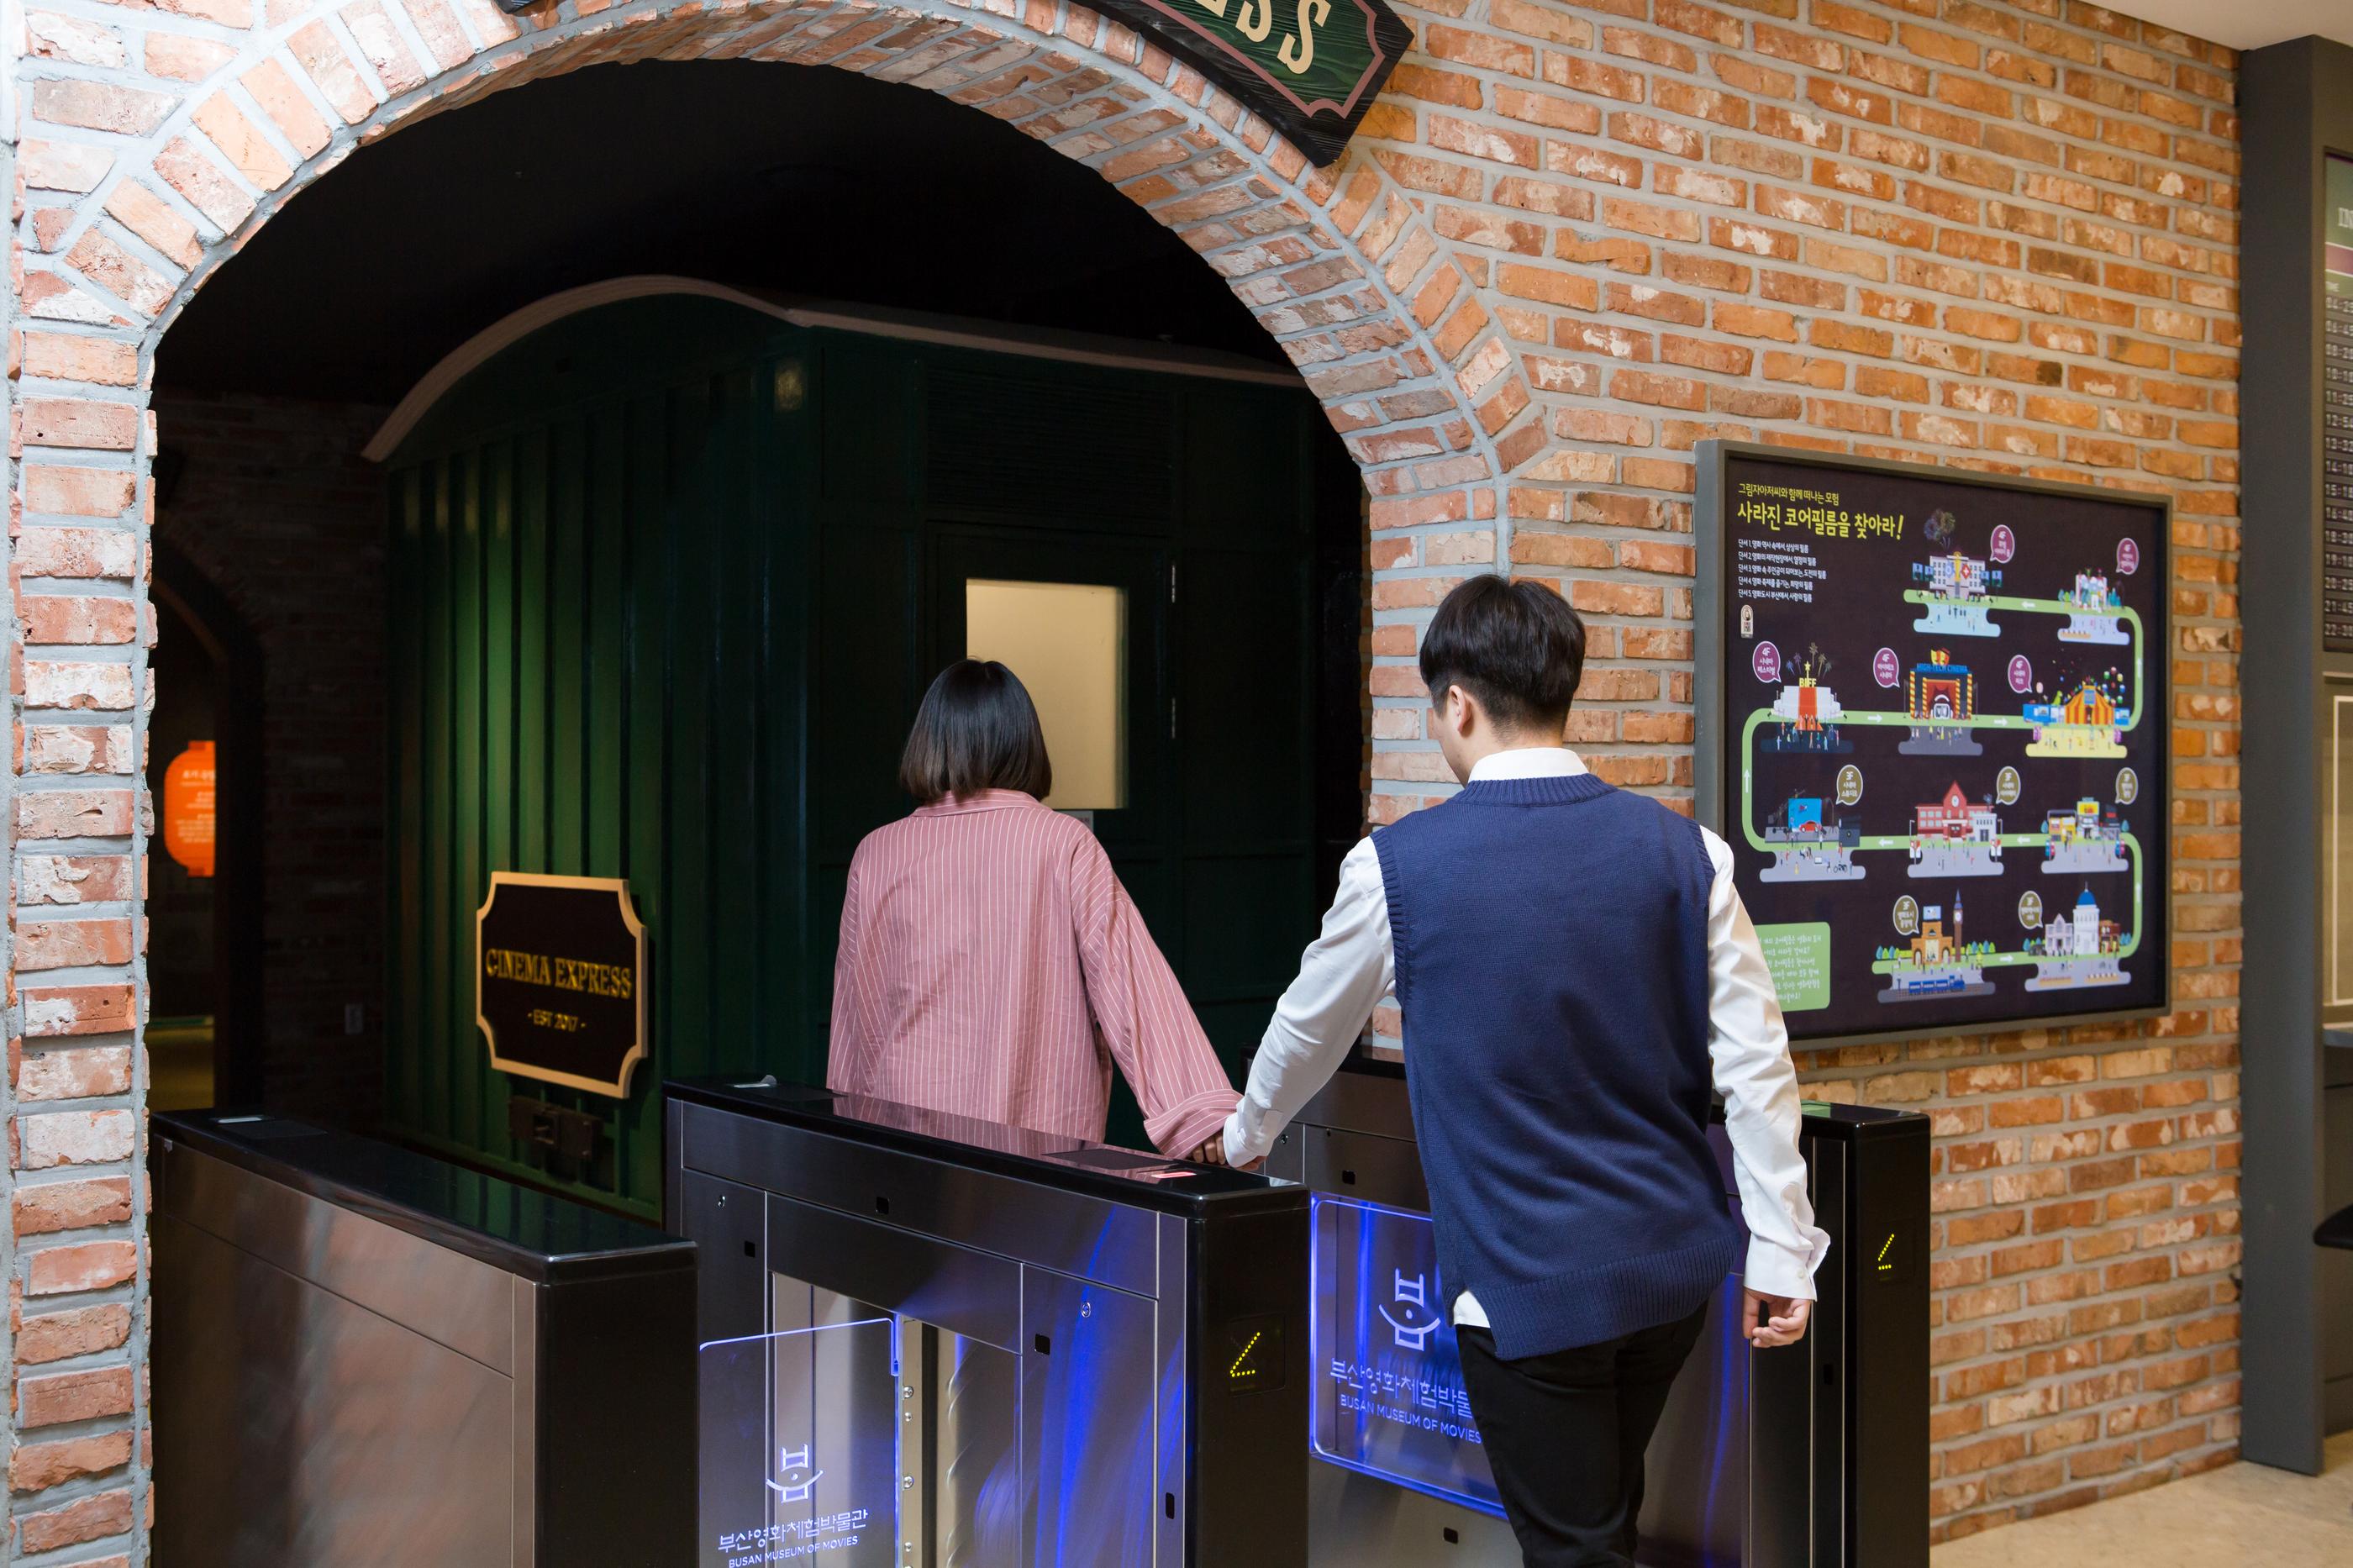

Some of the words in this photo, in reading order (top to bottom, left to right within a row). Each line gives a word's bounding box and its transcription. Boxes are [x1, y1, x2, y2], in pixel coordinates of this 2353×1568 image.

[1195, 0, 1332, 74] SS
[1738, 483, 1787, 498] 그림자아저씨와
[1788, 488, 1803, 502] 함께
[1803, 490, 1824, 504] 떠나는
[1824, 492, 1840, 506] 모험
[1737, 500, 1781, 531] 사라진
[1784, 506, 1850, 538] 코어필름을
[1854, 513, 1904, 540] 찾아라!
[1799, 677, 1817, 687] BIFF
[486, 948, 551, 987] CINEMA
[554, 957, 632, 999] EXPRESS
[1330, 1357, 1473, 1419] 부산영화체험박물
[1340, 1393, 1375, 1415] BUSAN
[1377, 1404, 1421, 1427] MUSEUM
[1423, 1418, 1438, 1432] OF
[1440, 1422, 1482, 1444] MOVIES
[718, 1508, 868, 1553] 부산영화체험박물관
[729, 1554, 762, 1568] BUSAN
[765, 1545, 805, 1562] MUSEUM
[807, 1542, 820, 1554] OF
[822, 1535, 858, 1550] MOVIES
